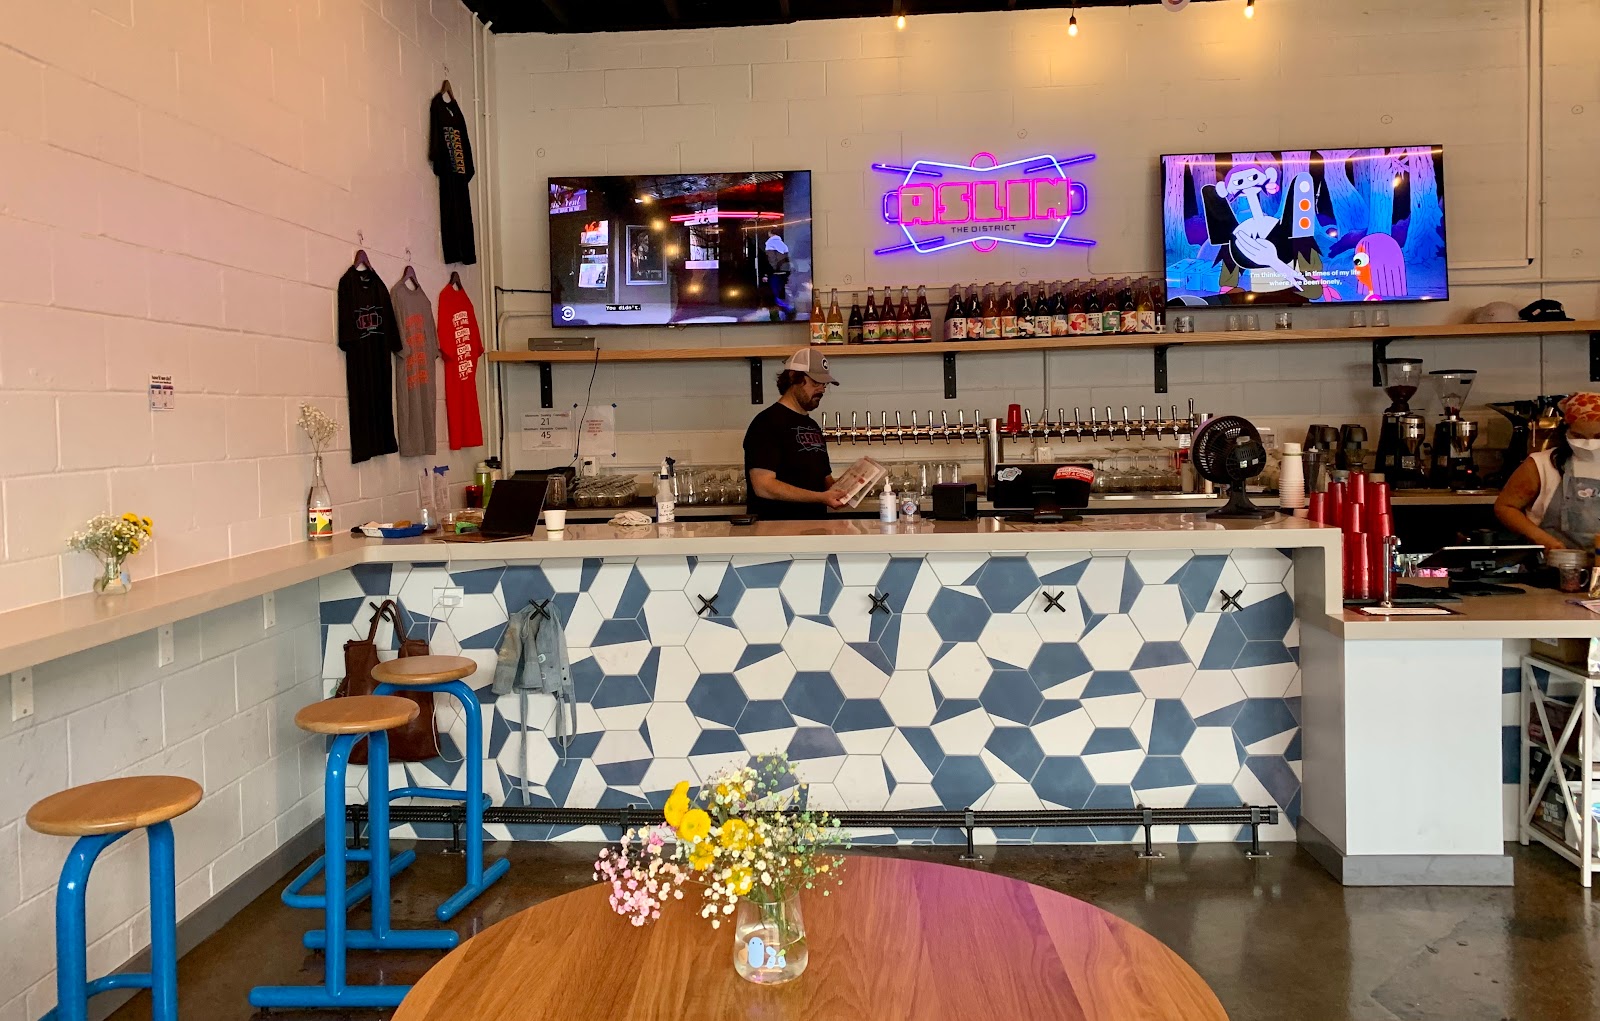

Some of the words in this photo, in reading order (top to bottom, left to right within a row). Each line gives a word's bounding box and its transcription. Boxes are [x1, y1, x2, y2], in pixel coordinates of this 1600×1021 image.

[898, 177, 1071, 225] ASLIN
[971, 224, 1017, 233] DISTRICT
[1320, 279, 1342, 287] lonely,
[541, 418, 550, 426] 21
[541, 431, 552, 439] 45
